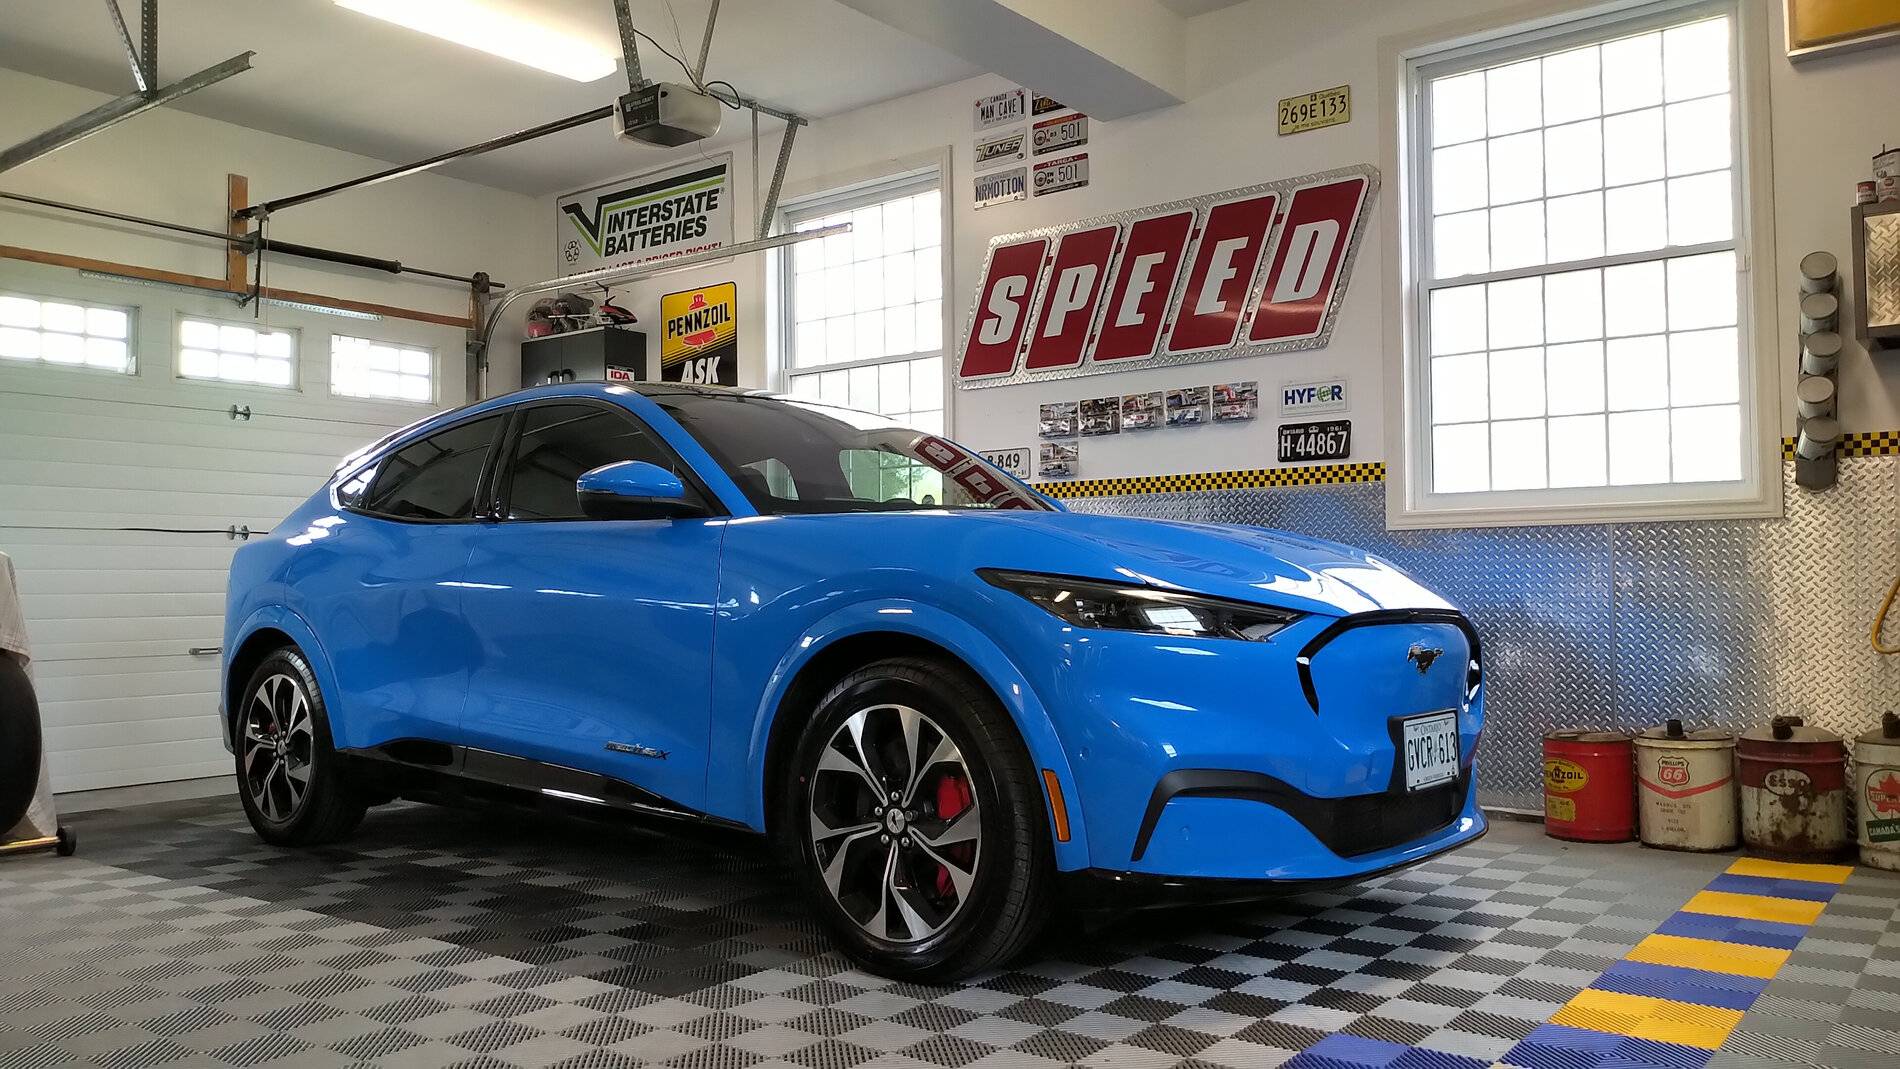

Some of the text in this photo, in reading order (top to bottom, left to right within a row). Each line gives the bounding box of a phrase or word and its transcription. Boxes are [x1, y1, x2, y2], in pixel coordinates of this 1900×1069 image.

[980, 104, 995, 121] MAN
[998, 98, 1017, 116] CAVE
[1281, 94, 1347, 126] 269E133
[1060, 121, 1080, 141] 501
[976, 134, 1024, 163] TUNER
[1058, 163, 1078, 182] 501
[975, 175, 1025, 202] NRMOTION
[607, 188, 720, 234] INTERSTATE
[604, 215, 708, 257] BATTERIES
[978, 218, 1341, 346] SPEED
[668, 303, 731, 340] PENNZOIL
[681, 356, 721, 385] ASK
[1284, 384, 1343, 405] HYFOR
[1407, 731, 1457, 771] GVCR 613
[1663, 768, 1684, 780] 66
